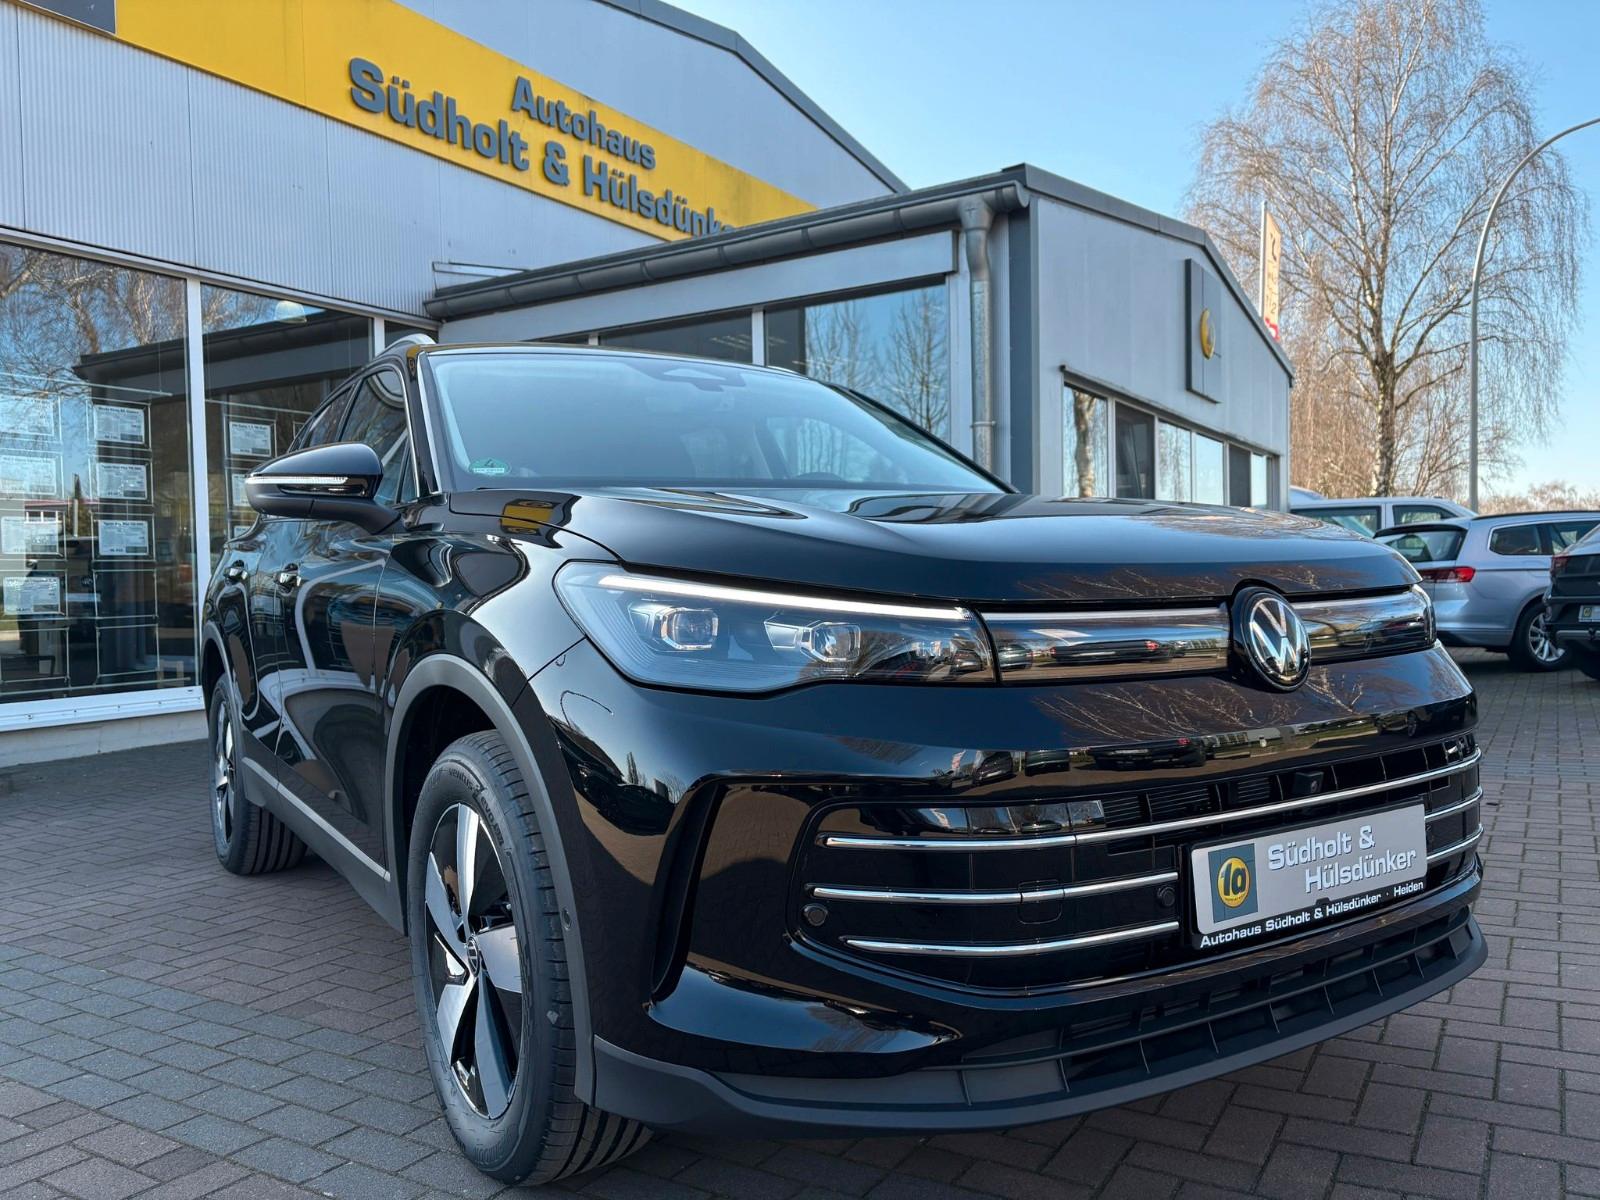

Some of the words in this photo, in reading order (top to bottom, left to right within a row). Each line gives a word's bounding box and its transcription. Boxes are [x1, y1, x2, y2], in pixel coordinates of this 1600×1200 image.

[349, 57, 529, 171] Südholt
[543, 140, 570, 186] &
[512, 76, 656, 169] Autohaus
[1267, 831, 1352, 871] Südholt
[1359, 825, 1376, 850] &
[1305, 849, 1417, 893] Hülsdünker
[1200, 924, 1262, 949] Autohaus
[1265, 911, 1311, 931] Südholt
[1313, 907, 1324, 919] &
[1326, 893, 1382, 916] Hülsdünker
[1393, 881, 1424, 897] Heiden
